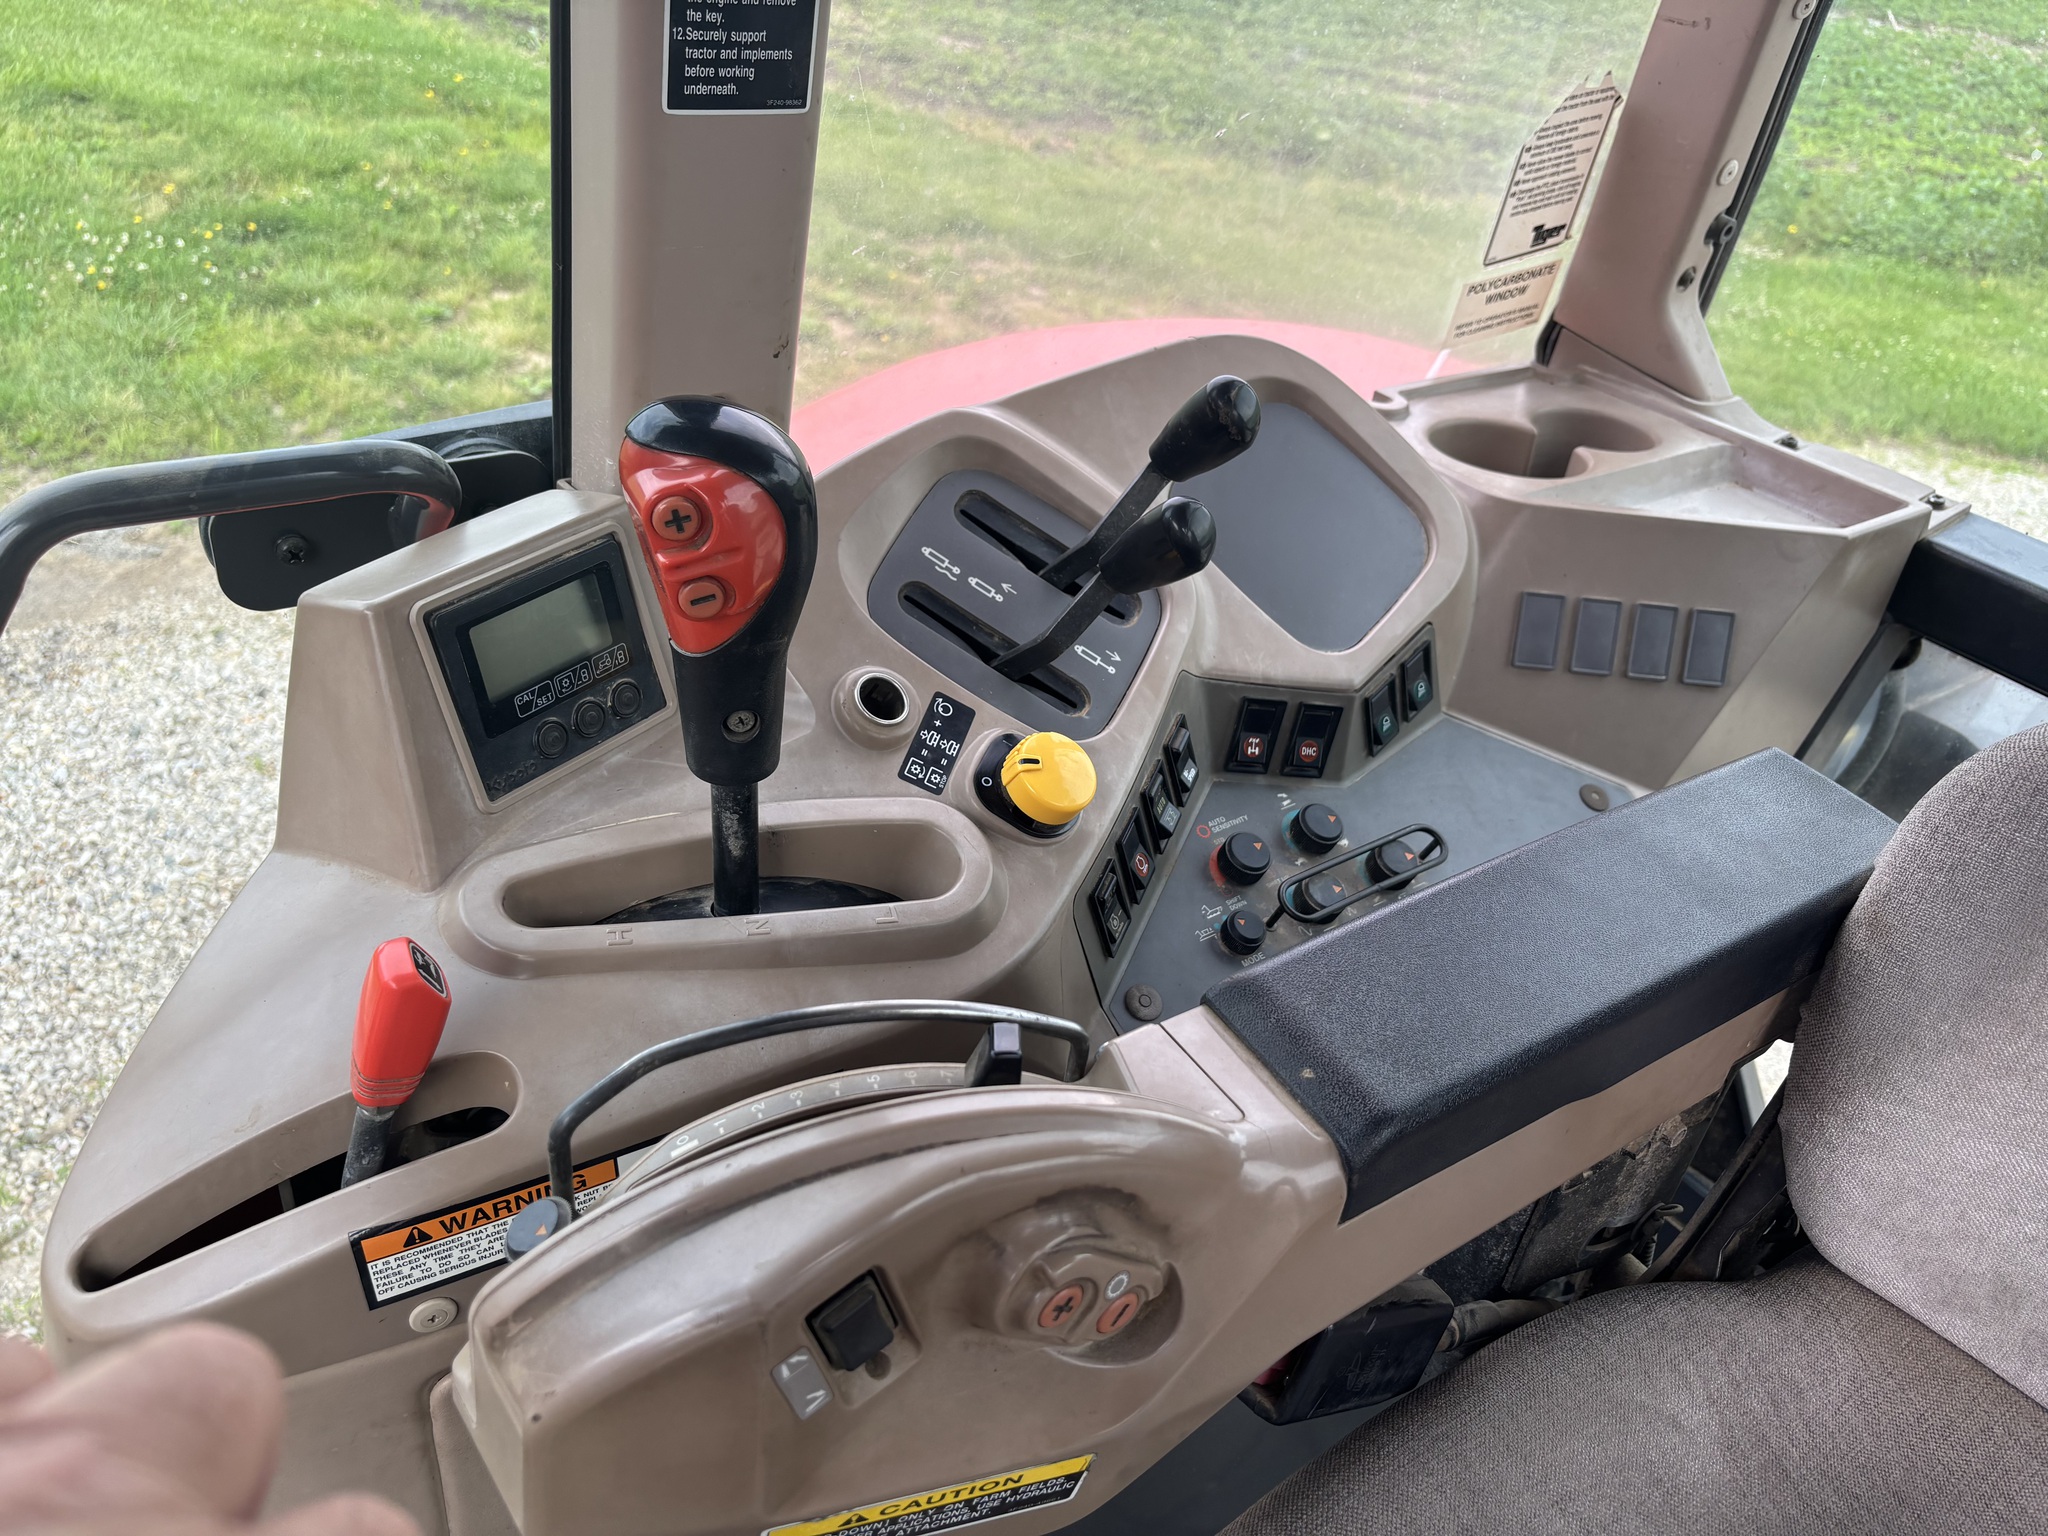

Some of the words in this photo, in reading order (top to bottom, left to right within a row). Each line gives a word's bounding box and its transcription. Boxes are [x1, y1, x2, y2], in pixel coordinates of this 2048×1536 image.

[686, 8, 702, 21] the
[705, 9, 725, 26] key.
[730, 30, 767, 45] support
[685, 46, 716, 60] tractor
[720, 47, 738, 60] and
[740, 47, 793, 63] implements
[684, 64, 715, 77] before
[718, 65, 755, 81] working
[683, 82, 739, 95] underneath.
[1466, 264, 1556, 296] POLYCARBONATE
[1485, 284, 1530, 305] WINDOW
[516, 692, 535, 706] CAL
[536, 692, 553, 706] SET
[1301, 746, 1317, 757] DHC
[938, 774, 947, 789] STOP
[1208, 816, 1226, 827] AUTO
[1211, 814, 1248, 833] SENSITIVITY
[1225, 895, 1242, 906] SHIFT
[1229, 900, 1248, 911] DOWN
[1241, 952, 1267, 968] MODE
[583, 1188, 600, 1198] NUT
[439, 1174, 587, 1235] WARNIG
[370, 1263, 379, 1271] IT
[394, 1236, 463, 1263] RECOMMENDED
[466, 1227, 489, 1239] THAT
[492, 1220, 509, 1230] THE
[373, 1257, 421, 1277] REPLACED
[422, 1241, 472, 1261] WHENEVER
[474, 1228, 508, 1243] BLADES
[374, 1269, 404, 1283] THESE
[409, 1261, 428, 1272] ANY
[433, 1253, 454, 1264] TIME
[459, 1243, 482, 1255] THEY
[487, 1235, 506, 1245] ARE
[376, 1273, 414, 1290] FAILURE
[419, 1267, 433, 1275] TO
[438, 1261, 452, 1269] DO
[457, 1253, 470, 1261] SO
[476, 1245, 495, 1255] CAN
[377, 1286, 396, 1296] OFF
[397, 1272, 437, 1289] CAUSING
[438, 1258, 477, 1275] SERIOUS
[478, 1248, 506, 1261] INJUR
[879, 1474, 1024, 1516] CAUTION
[898, 1508, 937, 1523] ONLY
[944, 1501, 965, 1510] ON
[972, 1489, 1012, 1505] FARM
[1018, 1476, 1068, 1493] FIELDS.
[977, 1499, 1001, 1510] USE
[1006, 1480, 1076, 1503] HYDRAULIC
[895, 1508, 991, 1536] ATTACHMENT.
